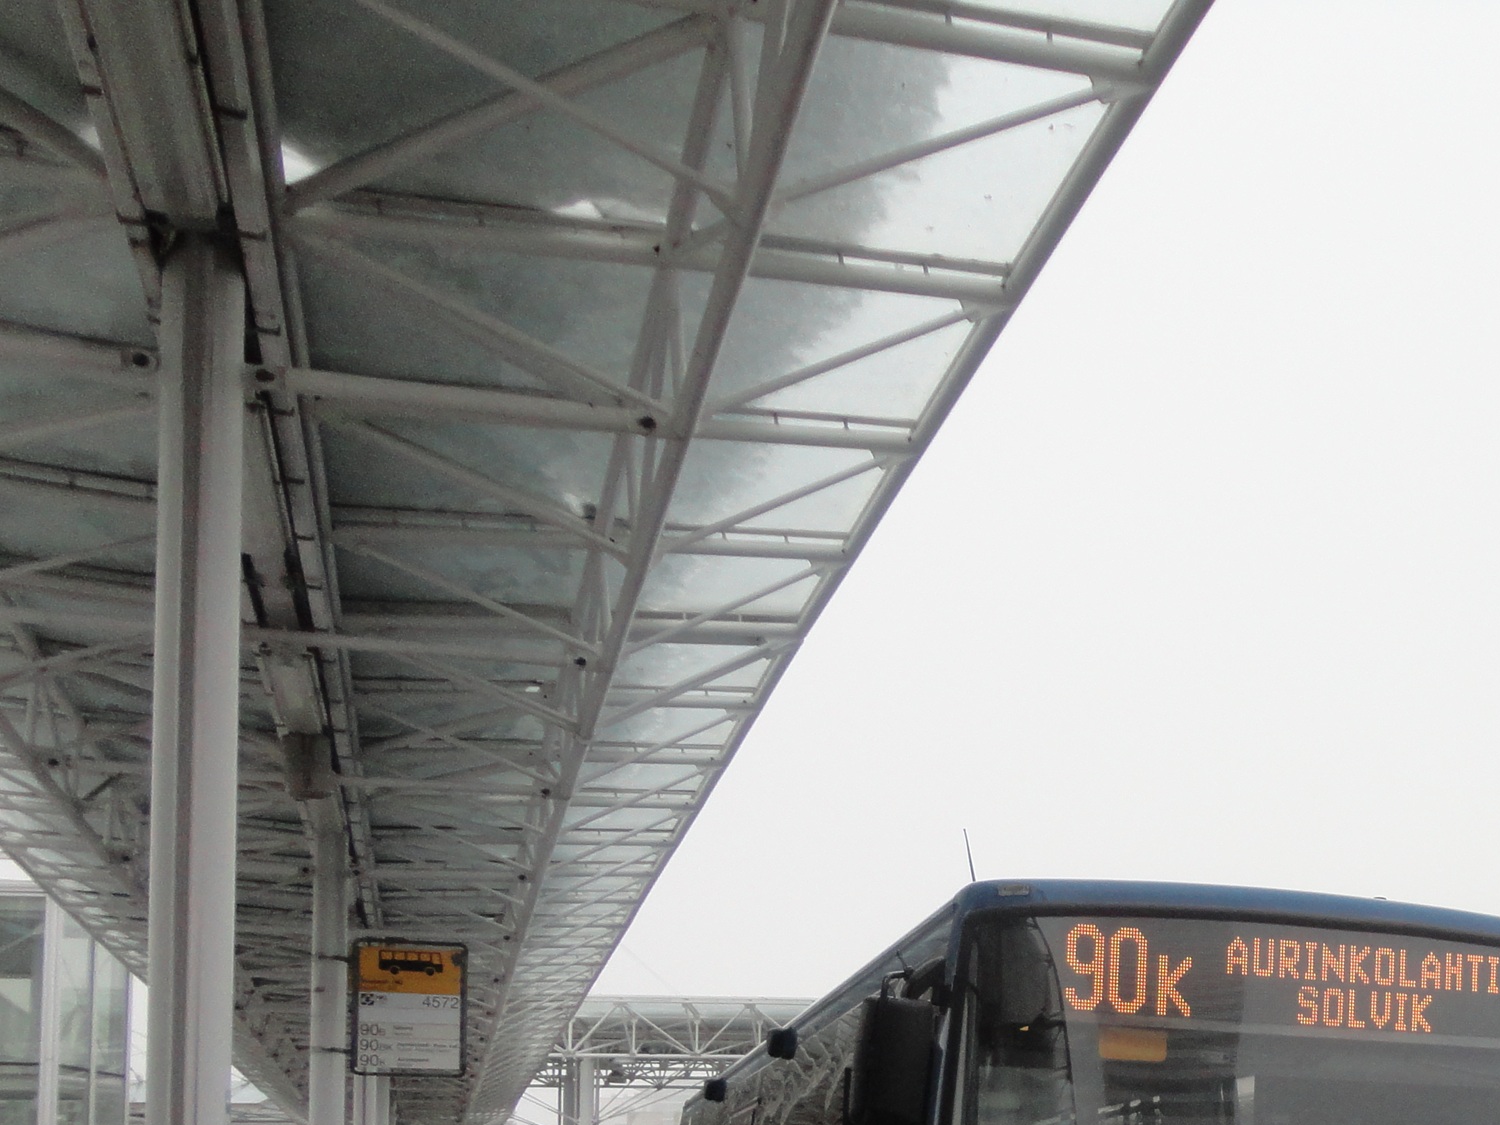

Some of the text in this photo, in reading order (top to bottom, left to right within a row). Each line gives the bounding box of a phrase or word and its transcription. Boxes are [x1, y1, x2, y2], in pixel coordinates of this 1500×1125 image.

[1226, 935, 1500, 993] AURINKOLAHTI
[422, 996, 459, 1009] 4572
[1297, 986, 1432, 1033] SOLVIK
